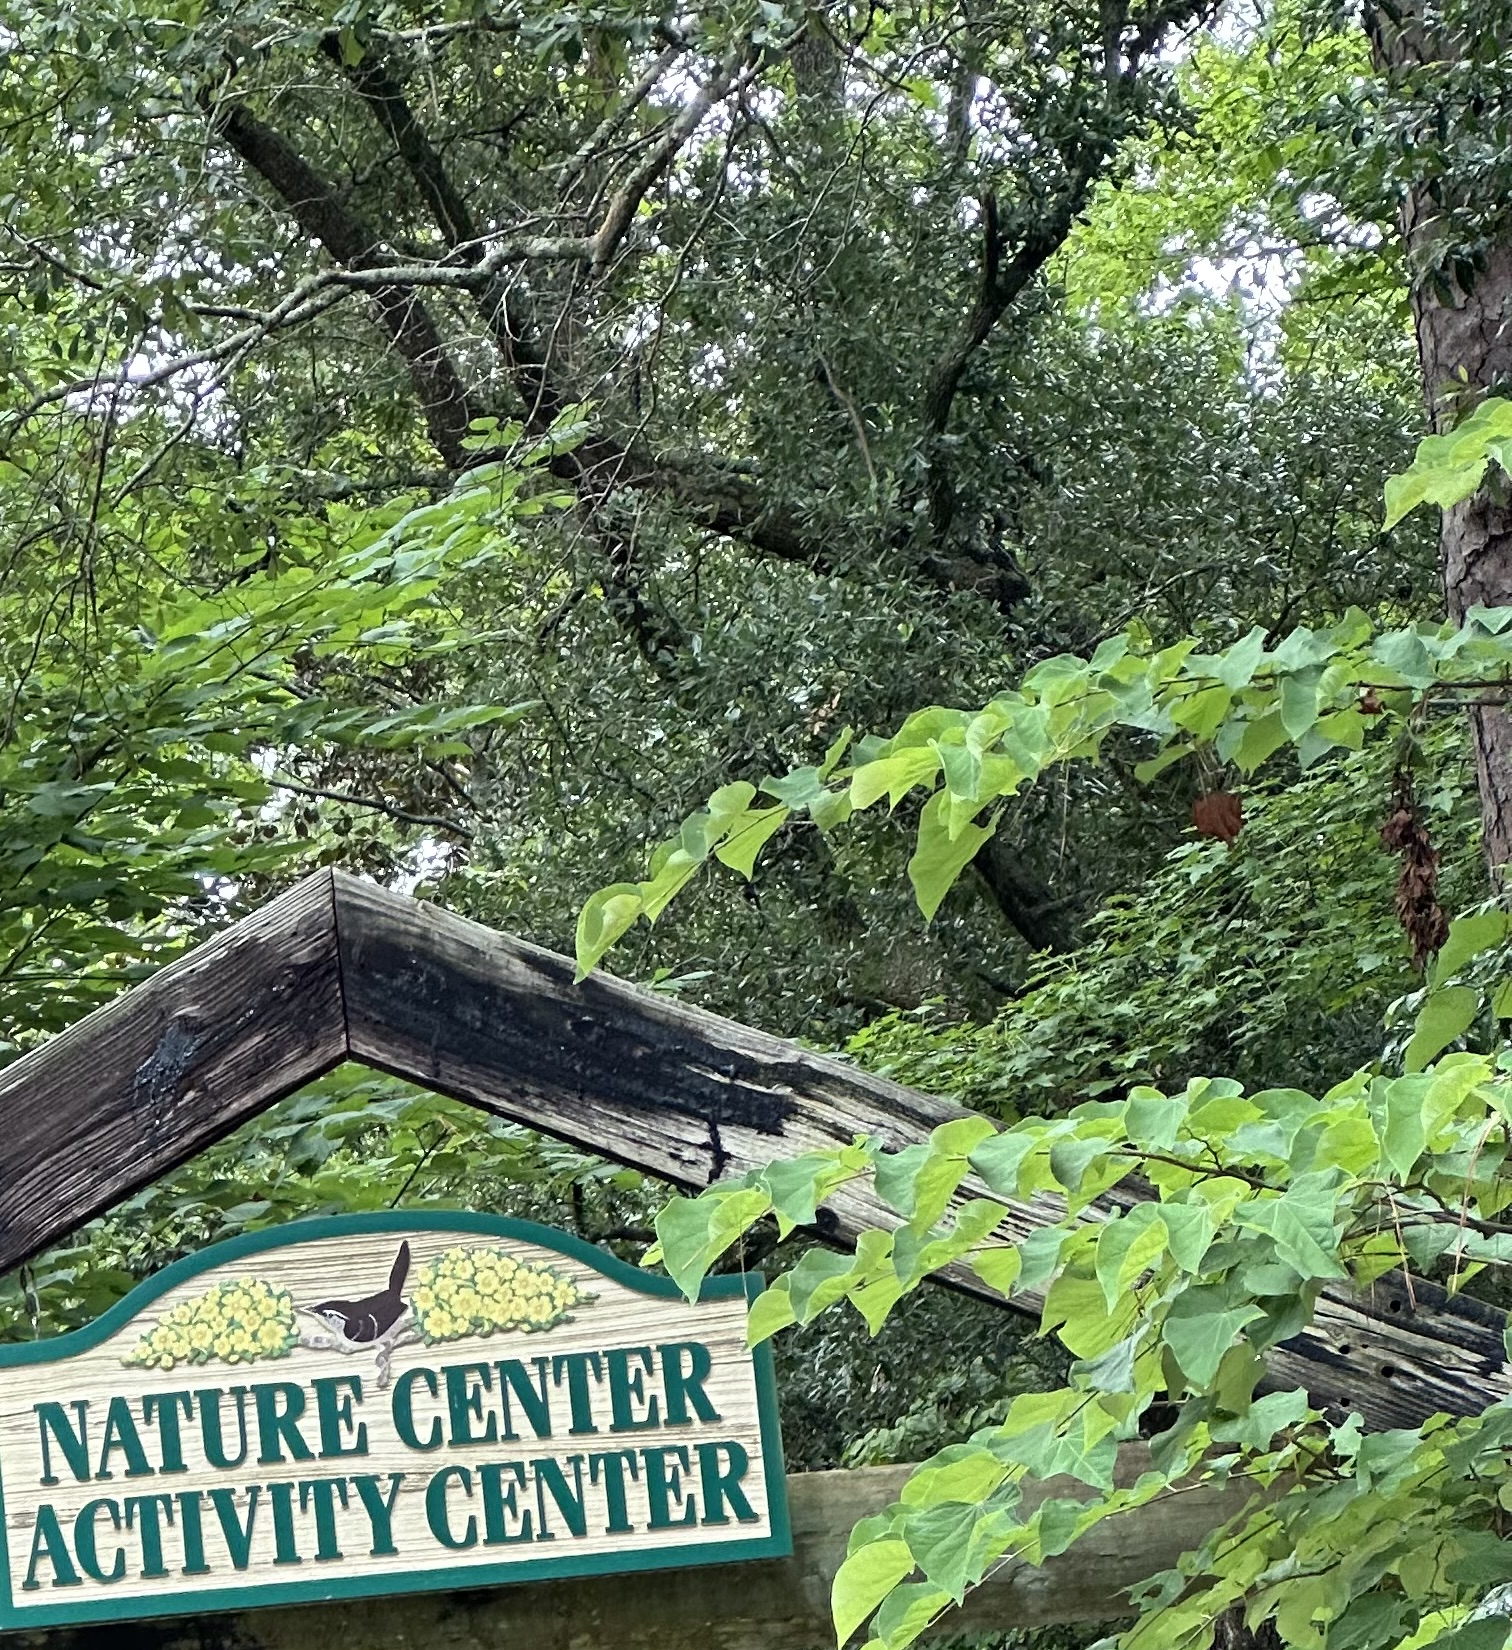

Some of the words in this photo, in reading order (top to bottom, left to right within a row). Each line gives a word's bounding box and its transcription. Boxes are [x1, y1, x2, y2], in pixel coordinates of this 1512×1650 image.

[34, 1375, 370, 1486] NATURE
[392, 1341, 722, 1452] CENTER
[22, 1472, 405, 1591] ACTIVITY
[425, 1440, 760, 1550] CENTER
